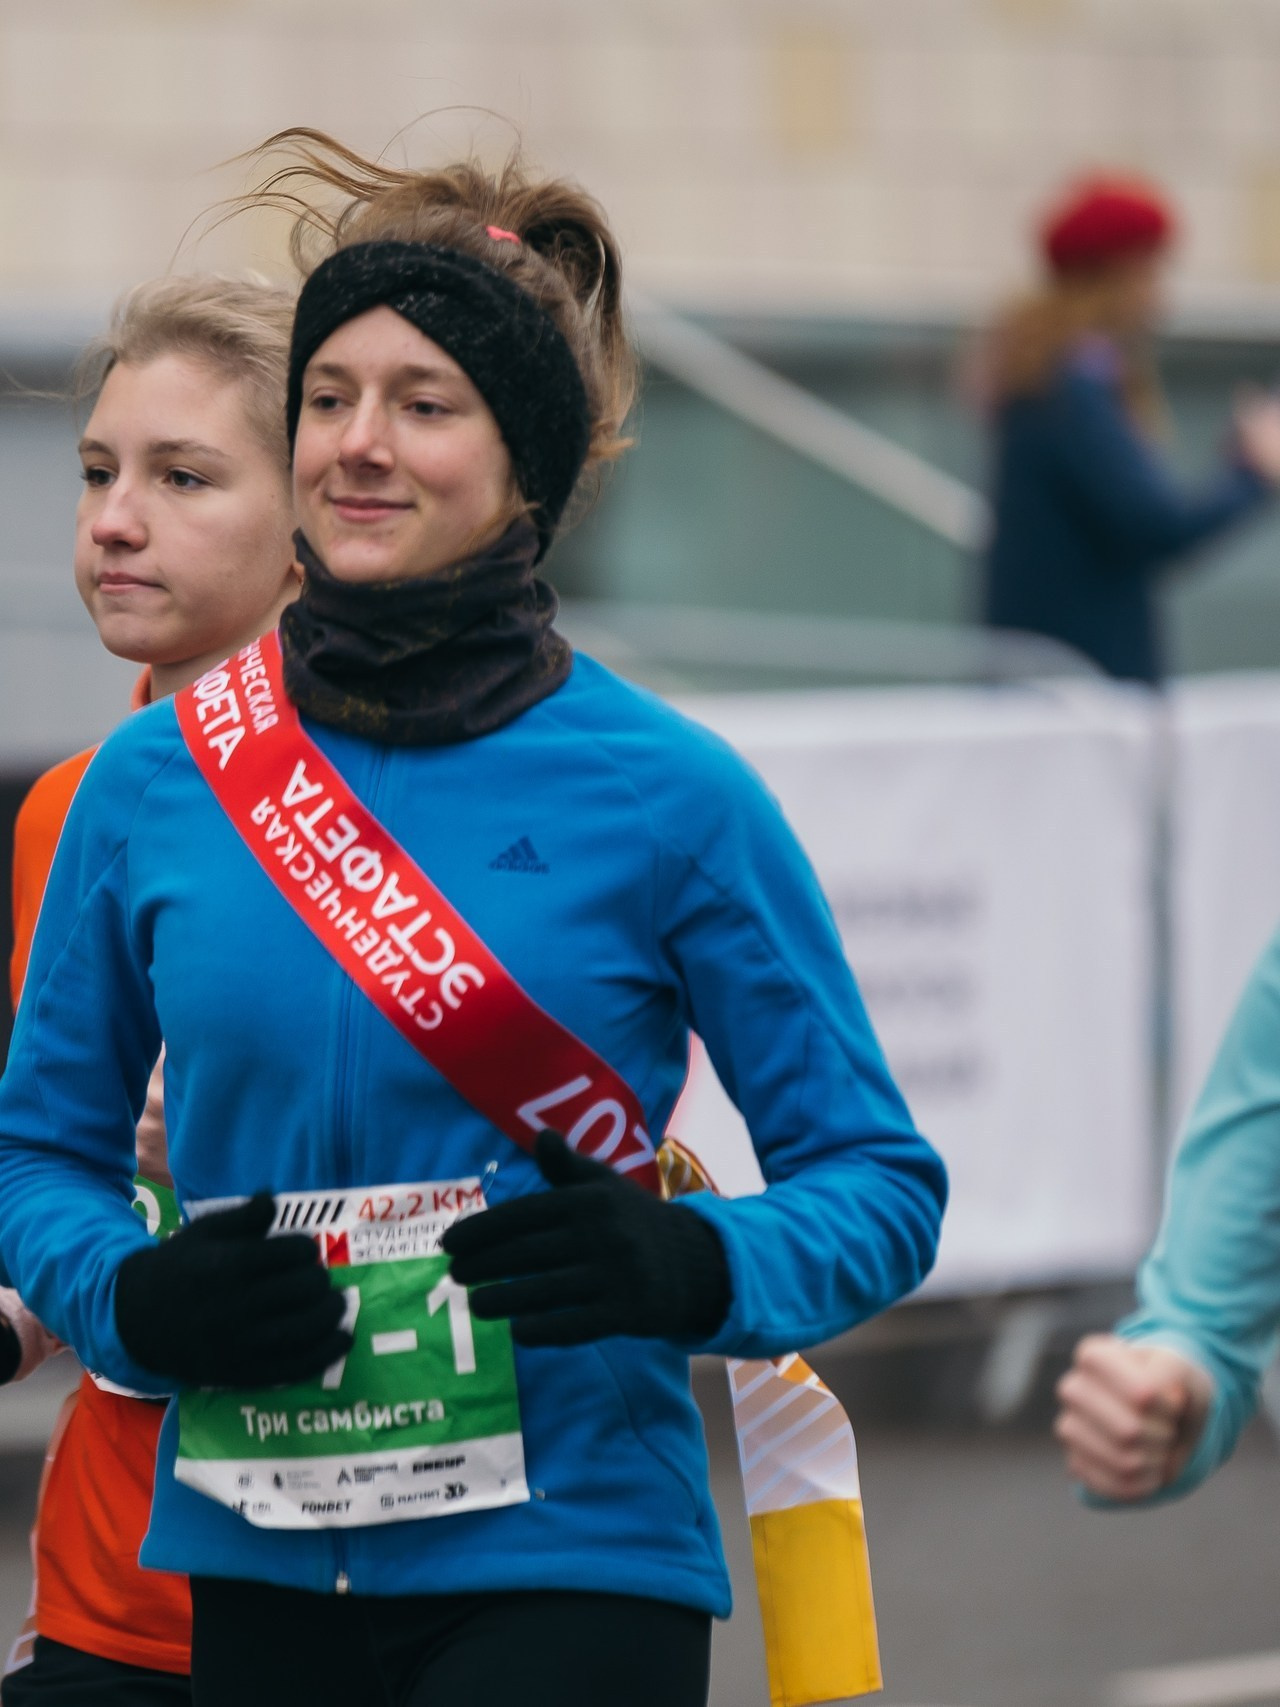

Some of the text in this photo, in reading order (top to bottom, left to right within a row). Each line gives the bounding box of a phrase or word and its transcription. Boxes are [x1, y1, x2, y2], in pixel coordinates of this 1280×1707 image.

[250, 796, 444, 1030] СТУДЕНЧЕСКАЯ
[281, 758, 486, 1010] ЭСТАФЕТА
[358, 1192, 426, 1222] 42,2
[240, 1398, 445, 1442] Три самбиста
